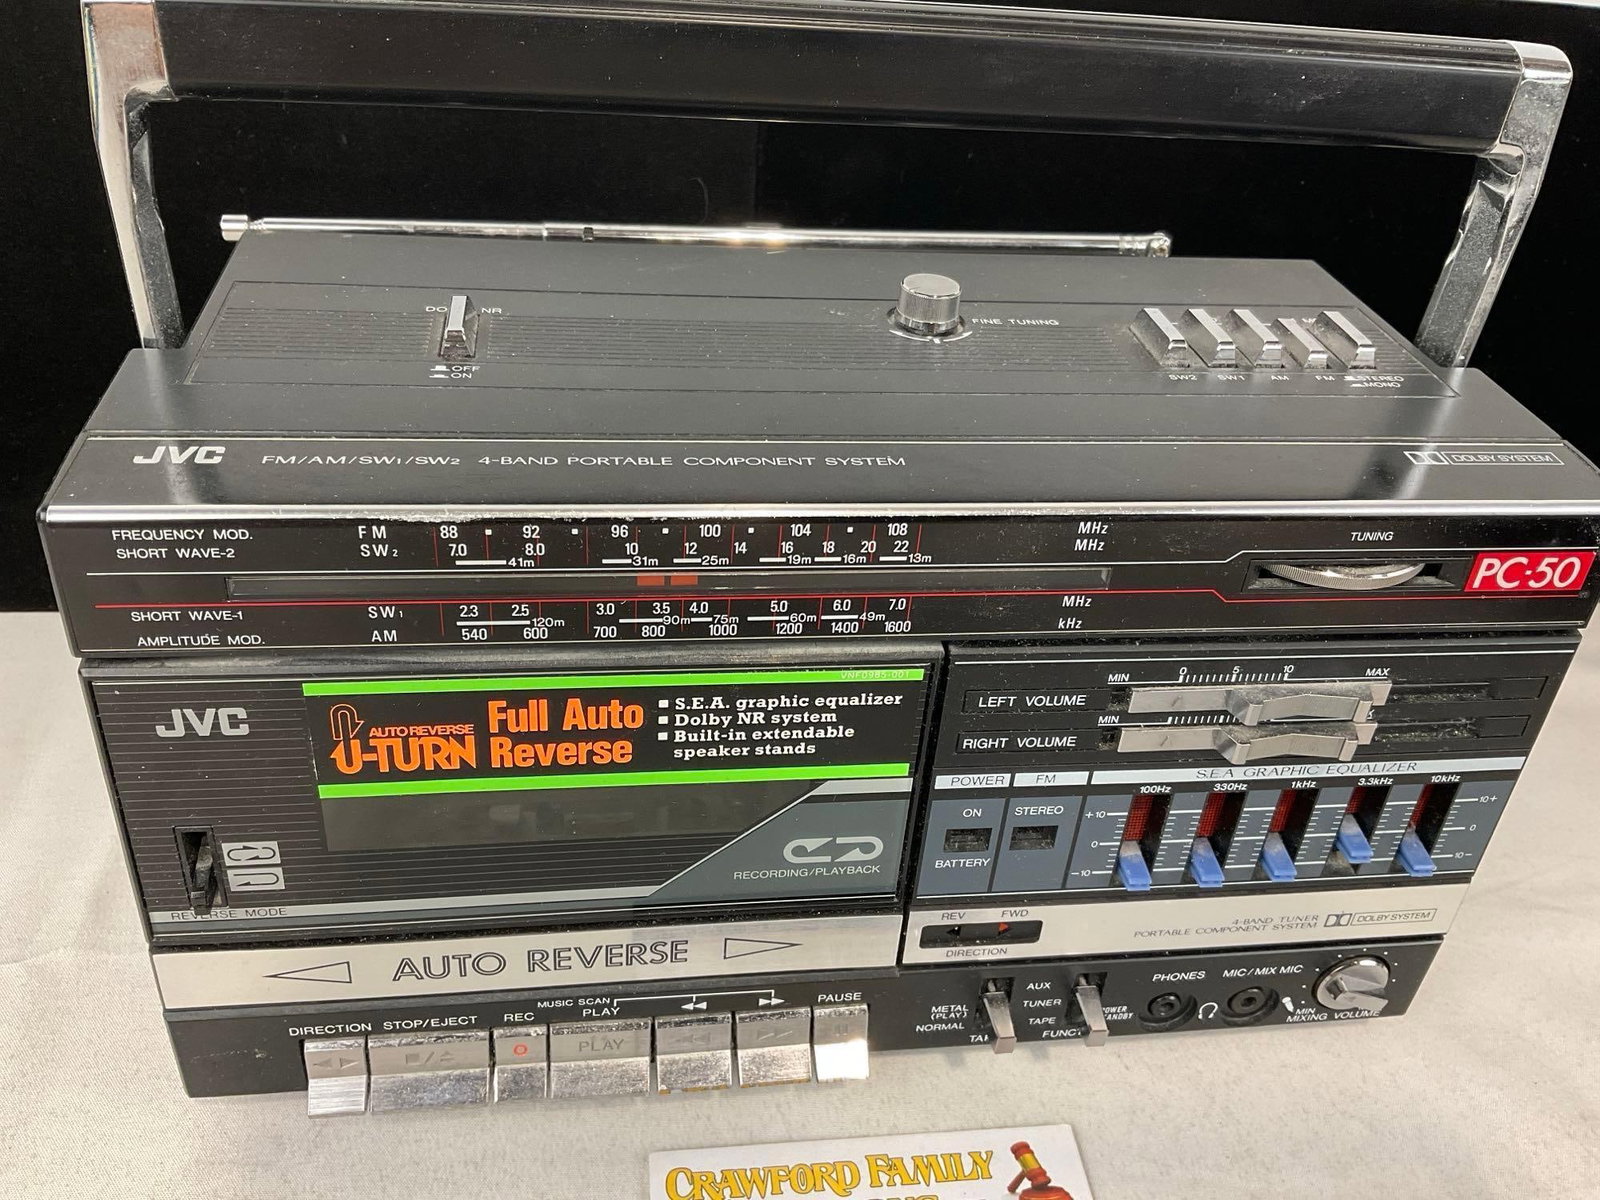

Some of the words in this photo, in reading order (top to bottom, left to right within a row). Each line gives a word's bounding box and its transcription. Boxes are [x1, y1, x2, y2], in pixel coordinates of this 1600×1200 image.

[1007, 318, 1060, 326] TUNING
[133, 446, 226, 464] JVC
[477, 455, 559, 466] 4-BAND
[566, 456, 674, 466] PORTABLE
[683, 456, 816, 467] COMPONENT
[824, 456, 906, 467] SYSTEM
[1451, 454, 1496, 462] DOLBY
[1497, 454, 1554, 462] SYSTEM
[111, 529, 205, 542] FREQUENCY
[212, 528, 254, 541] MOD.
[440, 526, 459, 539] 88
[522, 525, 541, 539] 92
[611, 524, 629, 538] 96
[699, 524, 722, 537] 100
[790, 523, 812, 537] 104
[887, 523, 909, 536] 108
[1078, 521, 1109, 534] MHz
[1350, 531, 1395, 542] TUNING
[116, 547, 168, 560] SHORT
[175, 547, 236, 560] WAVE-2
[449, 543, 468, 557] 7.0
[524, 543, 545, 556] 8.0
[625, 542, 639, 555] 10
[684, 542, 698, 555] 12
[734, 541, 748, 554] 14
[780, 541, 794, 554] 16
[822, 541, 836, 554] 18
[860, 540, 877, 553] 20
[893, 540, 909, 553] 22
[1074, 538, 1105, 551] MHz
[507, 557, 535, 568] 41m
[632, 556, 659, 566] 31m
[701, 555, 730, 565] 25m
[787, 554, 812, 564] 19m
[843, 554, 867, 564] 16m
[908, 553, 933, 563] 13m
[1472, 556, 1582, 589] PC-50
[459, 605, 479, 618] 2.3
[511, 604, 530, 617] 2.5
[595, 602, 616, 616] 3.0
[652, 602, 671, 615] 3.5
[689, 601, 709, 614] 4.0
[770, 600, 788, 613] 5.0
[832, 599, 851, 612] 6.0
[888, 598, 907, 611] 7.0
[1061, 595, 1092, 607] MHz
[130, 610, 182, 622] SHORT
[188, 610, 244, 622] WAVE-1
[531, 617, 566, 628] 120m
[662, 615, 692, 626] 90m
[713, 615, 739, 624] 75m
[789, 613, 818, 623] 60m
[858, 612, 886, 622] 49m
[371, 629, 398, 642] AM
[461, 628, 488, 641] 540
[523, 627, 549, 640] 600
[593, 626, 617, 638] 700
[641, 625, 666, 638] 800
[708, 624, 738, 637] 1000
[775, 623, 803, 636] 1200
[830, 622, 860, 634] 1400
[883, 621, 912, 634] 1600
[1057, 617, 1083, 629] kHz
[137, 634, 221, 648] AMPLITUDE
[227, 634, 267, 647] MOD.
[1107, 673, 1131, 682] MIN
[1365, 667, 1392, 677] MAX
[1178, 666, 1188, 676] 0
[1232, 665, 1241, 675] 5
[1283, 664, 1295, 674] 10
[675, 697, 731, 710] S.E.A.
[736, 694, 811, 712] graphic
[814, 693, 904, 709] equalizer
[978, 696, 1018, 708] LEFT
[1025, 694, 1088, 707] VOLUME
[487, 698, 549, 733] Full
[562, 698, 644, 731] Auto
[674, 712, 733, 728] Dolby
[736, 712, 767, 725] NR
[770, 711, 838, 726] system
[1097, 715, 1120, 724] MIN
[155, 708, 250, 738] JVC
[369, 725, 409, 738] AUTO
[409, 724, 475, 736] REVERSE
[673, 728, 748, 743] Built-in
[751, 726, 856, 741] extendable
[962, 737, 1010, 750] RIGHT
[1016, 736, 1078, 748] VOLUME
[330, 732, 477, 775] U-TURN
[489, 736, 634, 768] Reverse
[673, 745, 751, 760] speaker
[754, 743, 817, 757] stands
[1242, 764, 1320, 778] GRAPHIC
[1326, 761, 1419, 775] EQUALIZER
[950, 774, 1006, 787] POWER
[1035, 774, 1057, 785] FM
[1139, 785, 1173, 794] 100Hz
[1213, 783, 1249, 792] 330Hz
[1291, 779, 1318, 789] 1kHz
[1357, 777, 1395, 787] 3.3kHz
[1430, 774, 1462, 783] 10kHz
[962, 808, 983, 818] ON
[1014, 805, 1065, 817] STEREO
[934, 857, 992, 869] BATTERY
[733, 864, 882, 880] RECORDING/PLAYBACK
[245, 908, 289, 918] MODE
[941, 911, 968, 921] REV
[1001, 909, 1030, 919] FWD
[1356, 914, 1391, 923] DOLBY
[1391, 911, 1432, 921] SYSTEM
[1231, 917, 1275, 926] 4-BAND
[1279, 914, 1320, 924] TUNER
[1133, 928, 1192, 938] PORTABLE
[1195, 925, 1268, 935] COMPONENT
[1272, 922, 1319, 931] SYSTEM
[946, 947, 1009, 958] DIRECTION
[392, 951, 508, 982] AUTO
[527, 939, 690, 973] REVERSE
[1152, 970, 1206, 982] PHONES
[1278, 964, 1304, 975] MIC
[1026, 981, 1052, 991] AUX
[537, 999, 574, 1009] MUSIC
[577, 997, 611, 1007] SCAN
[817, 992, 863, 1003] PAUSE
[1023, 998, 1062, 1008] TUNER
[582, 1006, 621, 1018] PLAY
[931, 1004, 970, 1014] METAL
[1295, 1007, 1316, 1015] MIN
[503, 1012, 536, 1023] REC
[930, 1011, 968, 1021] (PLAY)
[1028, 1016, 1057, 1026] TAPE
[1286, 1012, 1328, 1023] MIXING
[1334, 1010, 1381, 1019] VOLUME
[383, 1015, 479, 1031] STOP/EJECT
[915, 1022, 966, 1033] NORMAL
[288, 1023, 373, 1037] DIRECTION
[578, 1038, 626, 1053] PLAY
[665, 1160, 861, 1200] CRAWFORD
[865, 1150, 994, 1189] FAMILY
